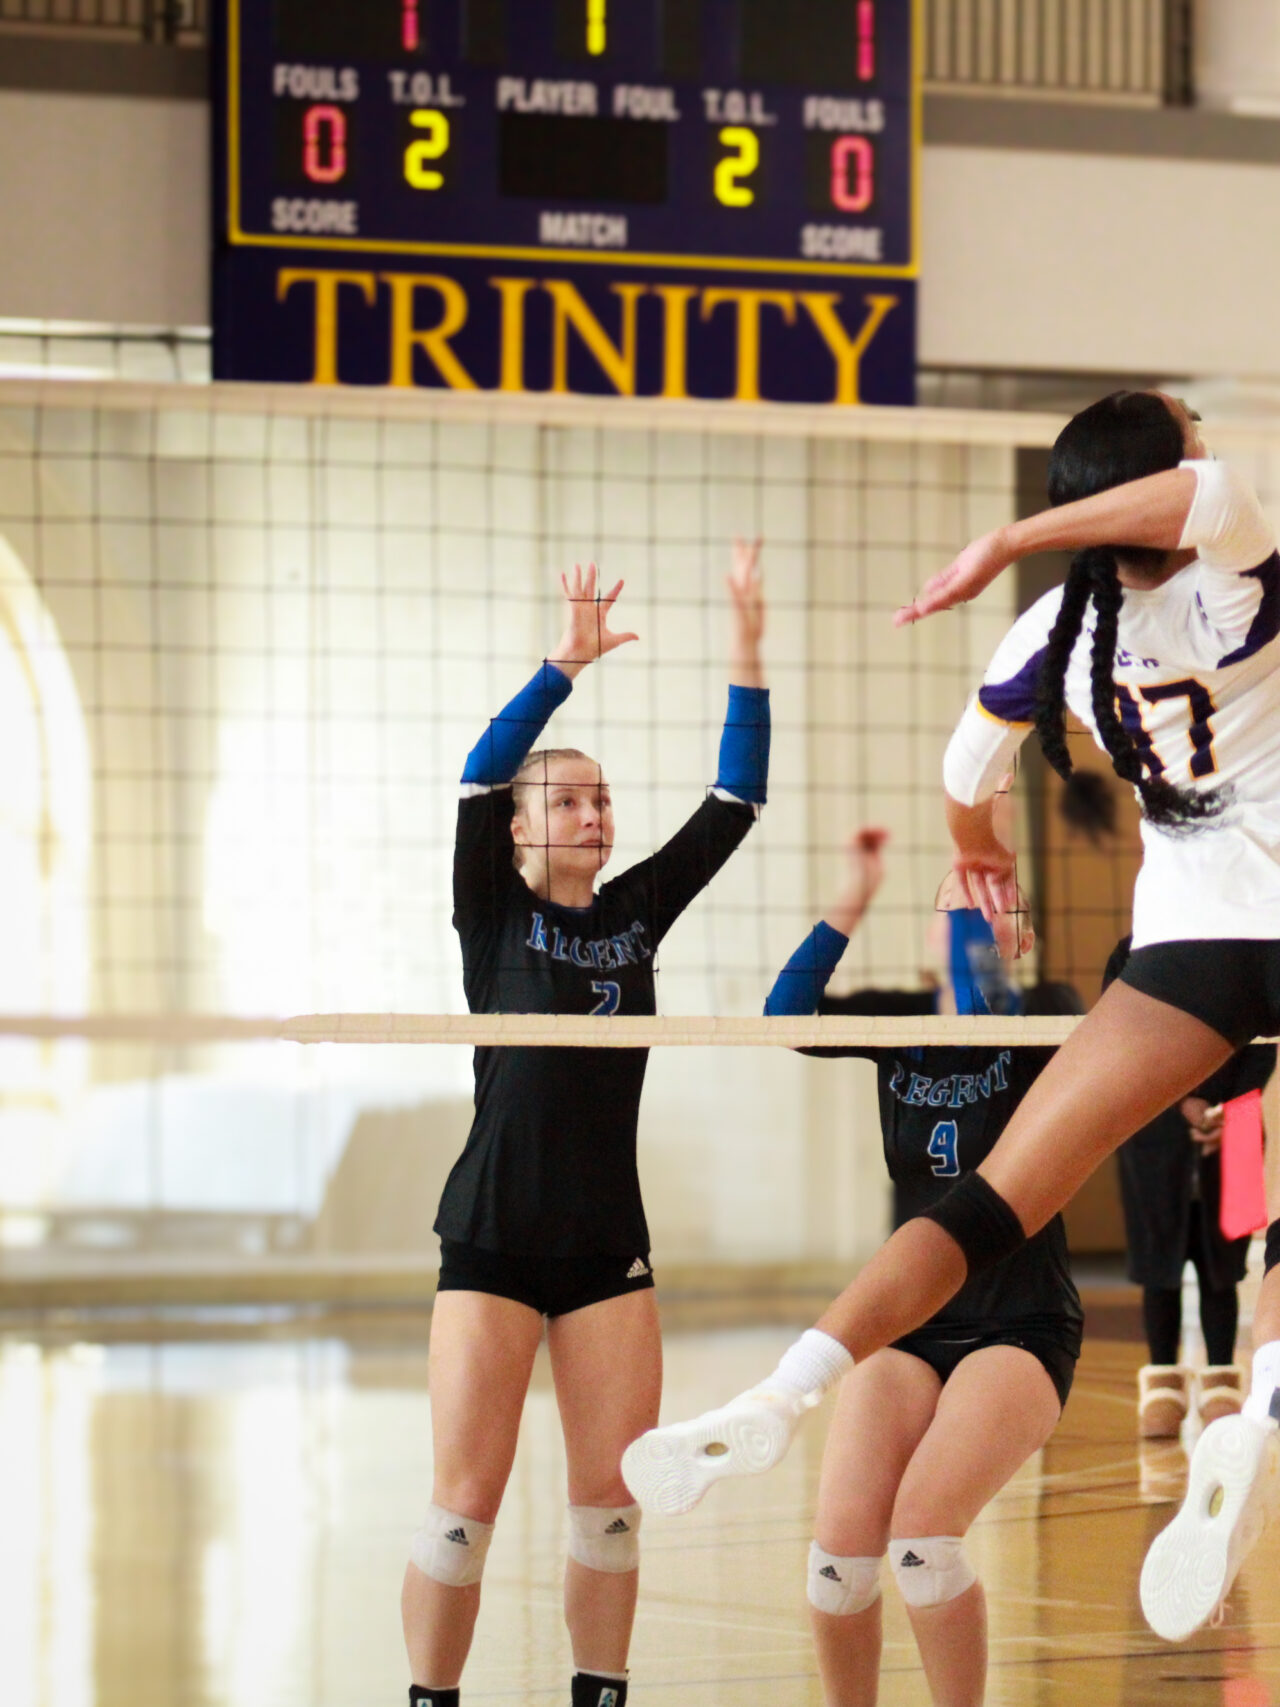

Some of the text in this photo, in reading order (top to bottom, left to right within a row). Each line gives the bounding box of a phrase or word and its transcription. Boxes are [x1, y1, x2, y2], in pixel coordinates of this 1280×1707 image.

[273, 63, 358, 101] FOULS
[388, 71, 464, 106] T.O.L.
[497, 76, 680, 120] PLAYER FOUL
[803, 96, 884, 133] FOULS
[304, 104, 345, 183] 0
[404, 109, 449, 190] 2
[714, 127, 759, 207] 2
[831, 135, 873, 212] 0
[272, 198, 358, 234] SCORE
[539, 212, 627, 247] MATCH
[801, 224, 882, 260] SCORE
[277, 267, 898, 405] TRINITY
[927, 1119, 960, 1177] 9
